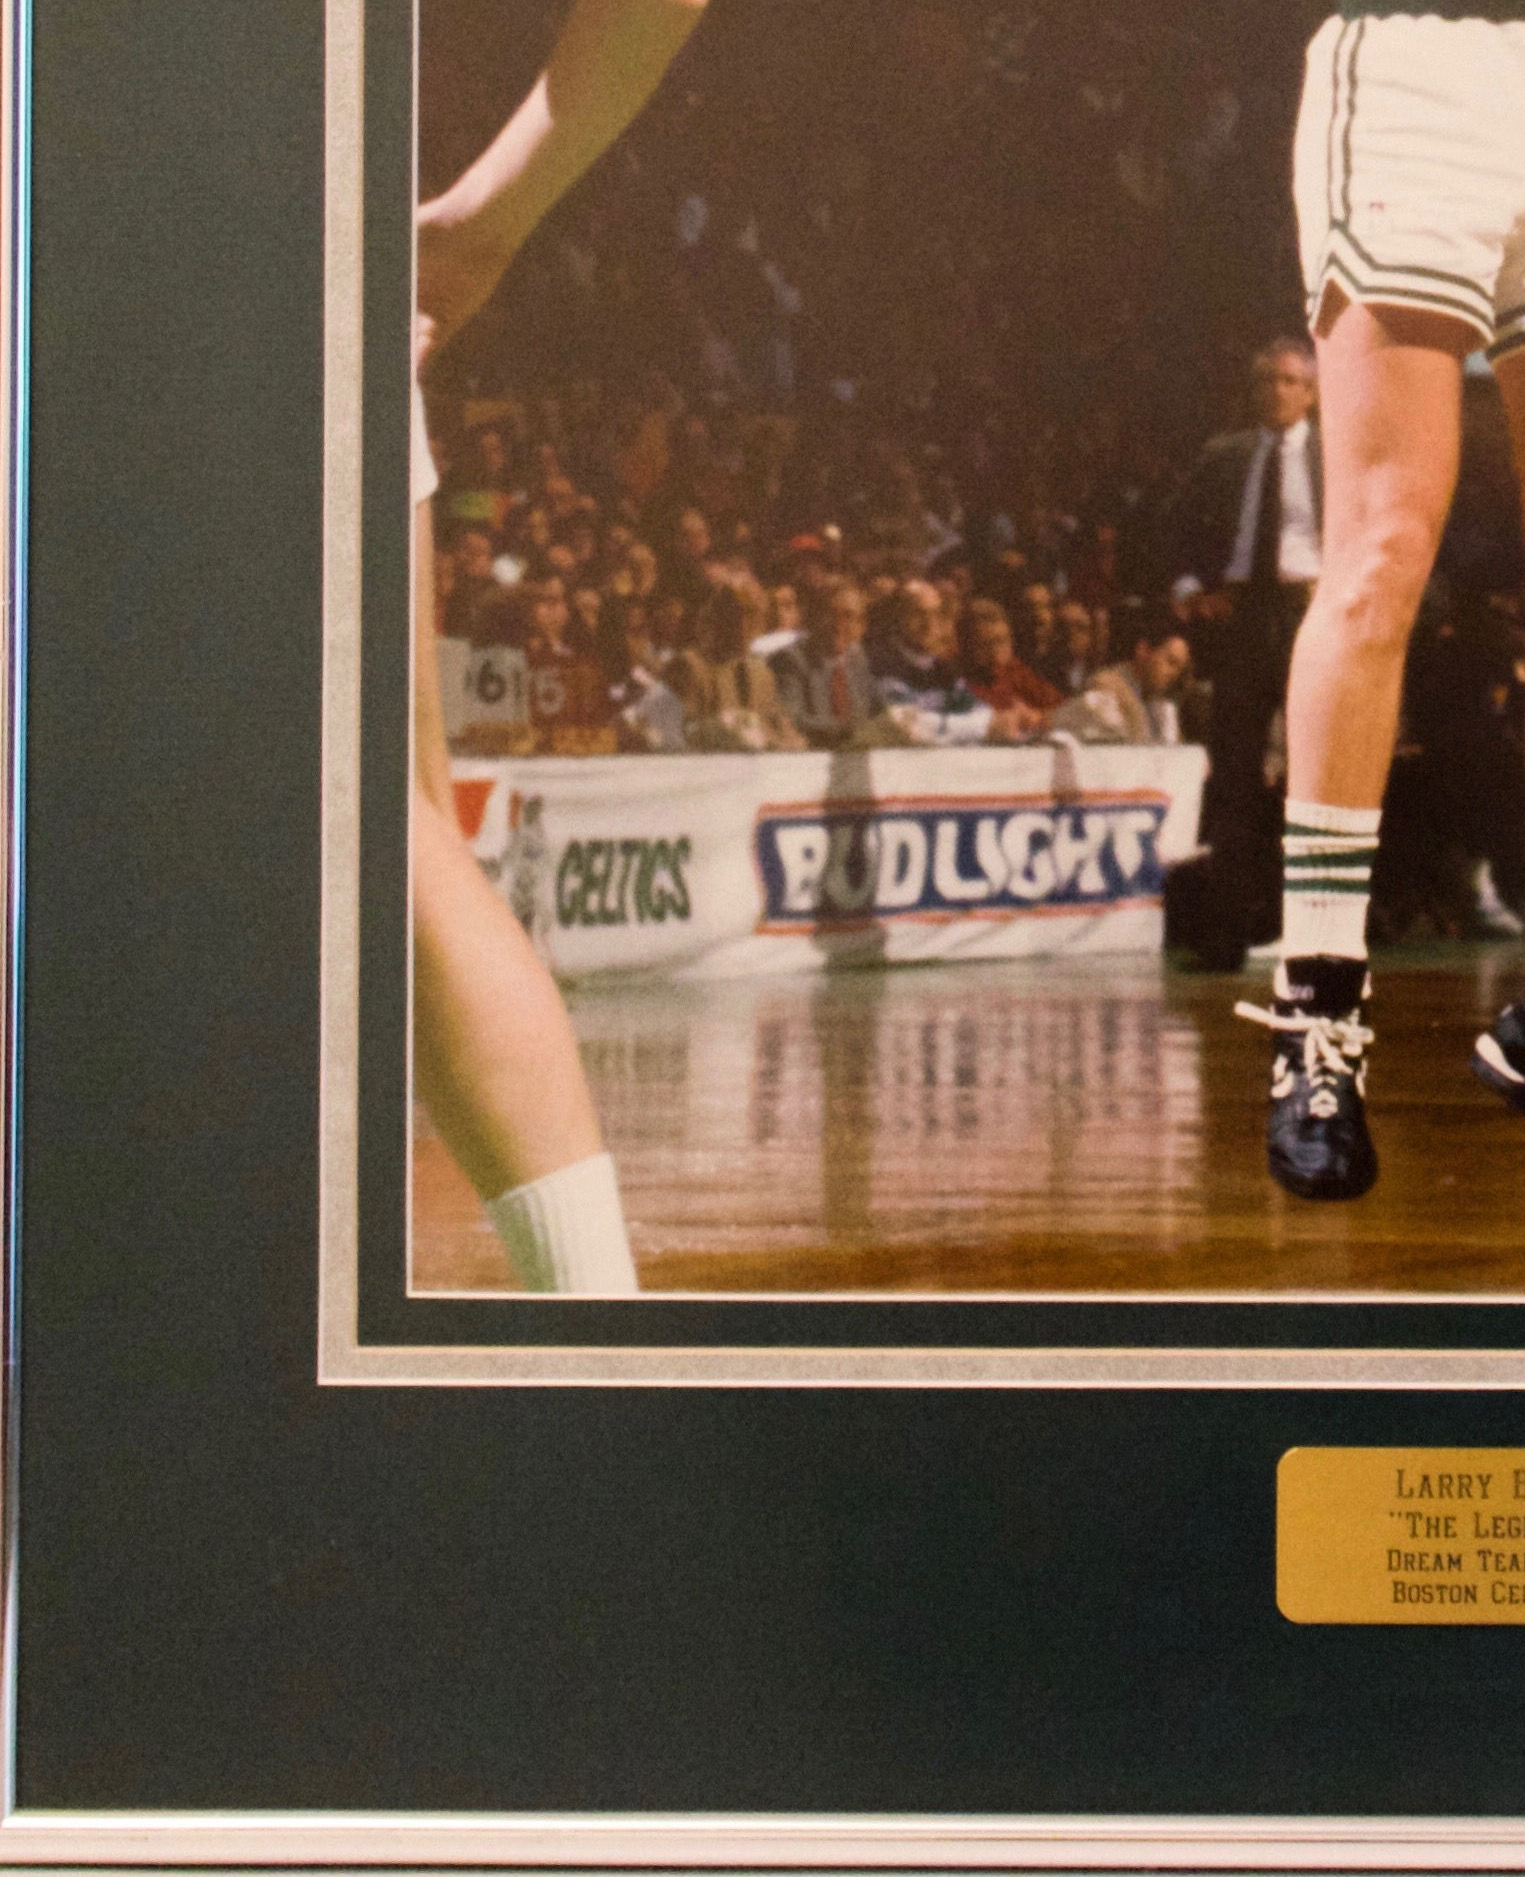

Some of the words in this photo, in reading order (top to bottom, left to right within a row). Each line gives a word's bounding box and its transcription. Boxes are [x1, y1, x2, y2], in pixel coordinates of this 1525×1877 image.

[556, 835, 691, 928] CELTICS
[1396, 1469, 1492, 1499] LARRY
[1387, 1549, 1463, 1572] DREAM
[1392, 1580, 1478, 1604] BOSTON
